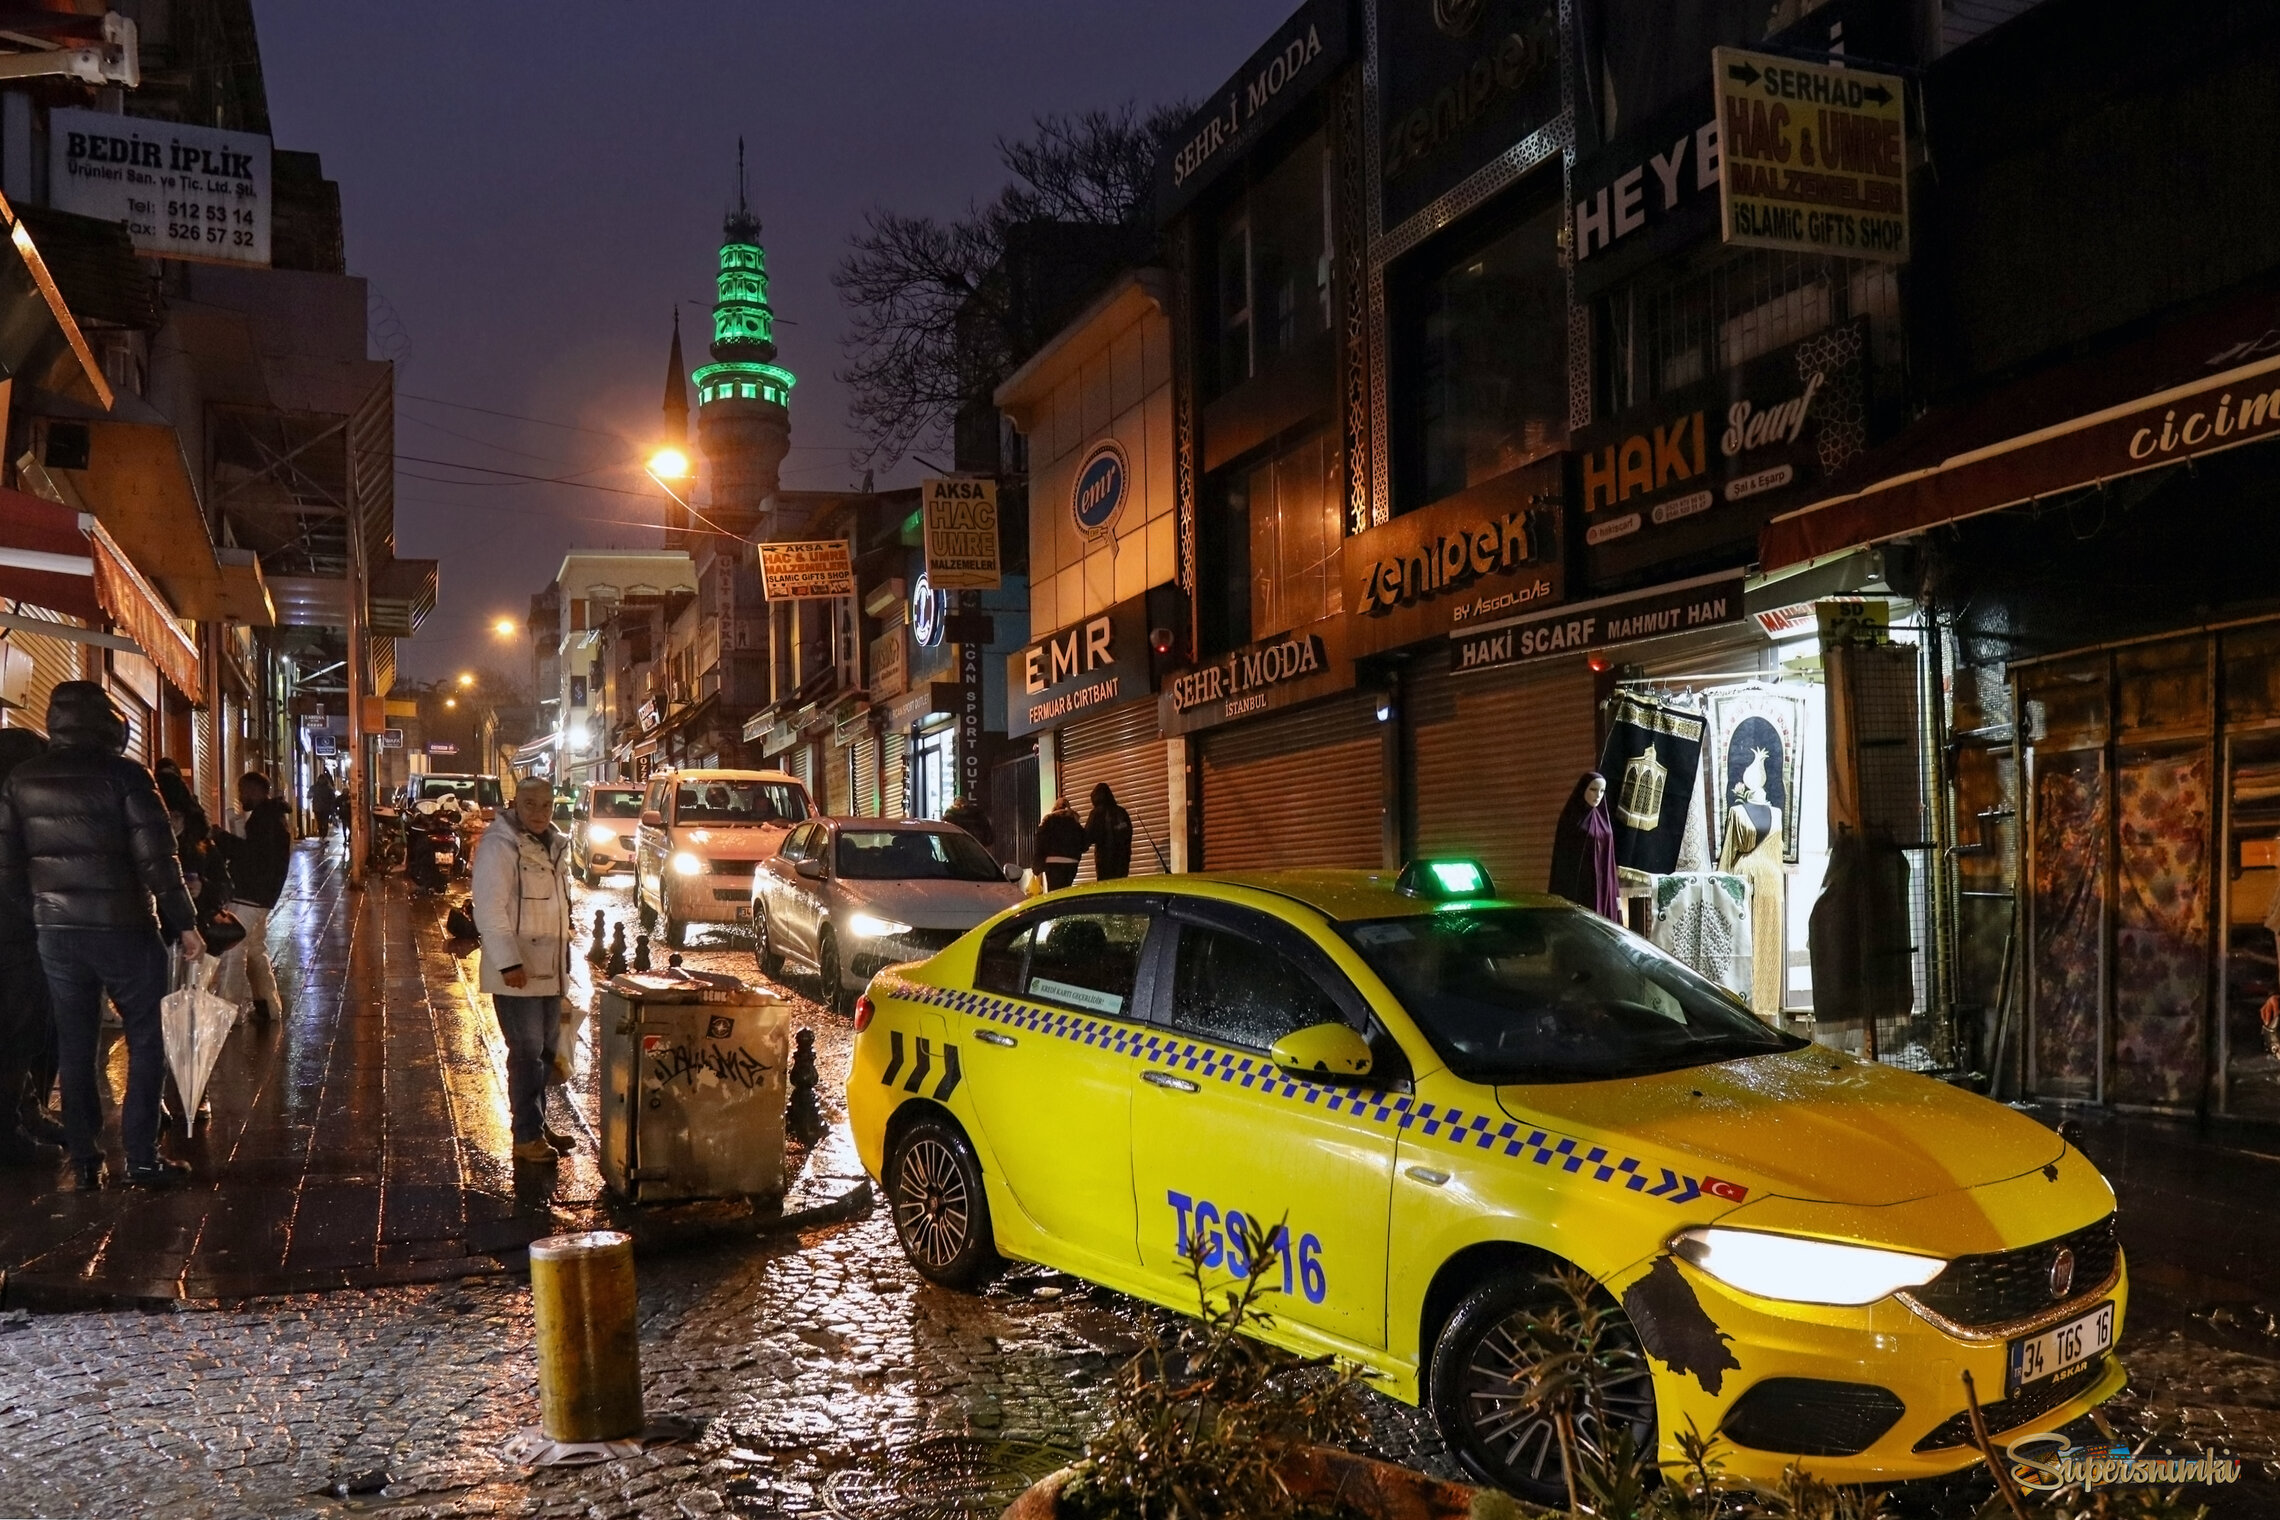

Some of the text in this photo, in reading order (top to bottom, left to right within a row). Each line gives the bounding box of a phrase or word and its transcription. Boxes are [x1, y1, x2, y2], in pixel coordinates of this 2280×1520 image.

[1247, 23, 1323, 119] MODA
[1764, 67, 1862, 108] SERHAD
[1726, 95, 1902, 178] HAC & UMRE
[67, 132, 253, 179] BEDİR İPLİK
[68, 160, 122, 181] Ürünleri
[127, 169, 156, 185] San.
[160, 176, 176, 188] ve
[180, 176, 203, 192] Tic.
[207, 180, 232, 194] Ltd.
[128, 198, 253, 226] Tel: 512 53 14
[169, 224, 200, 241] 526
[207, 228, 226, 244] 57
[233, 230, 254, 247] 32
[1860, 217, 1902, 251] SHOP
[1583, 371, 1825, 513] HAKI Scarf
[935, 483, 984, 499] AKSA
[1081, 465, 1116, 514] emr
[1734, 483, 1749, 497] Şal
[1758, 471, 1785, 489] Eşarp
[929, 501, 996, 530] HAC
[764, 550, 847, 564] HAC & UMRE
[786, 544, 823, 552] AKSA
[931, 531, 995, 557] UMRE
[828, 571, 850, 580] SHOP
[931, 558, 996, 570] MALZEMELERİ
[1454, 603, 1470, 621] BY
[1840, 603, 1864, 616] SD
[1463, 598, 1726, 667] HAKİ SCARF MAHMUT HAN
[1025, 616, 1115, 695] EMR
[1173, 634, 1318, 714] ŞEHR-İ MODA
[1029, 677, 1119, 725] FERMUAR & CIRTBANT
[1226, 693, 1267, 717] İSTANBUL
[966, 691, 978, 749] SPORT
[1167, 1189, 1326, 1304] TGS 16
[2024, 1311, 2109, 1378] 34 TGS 16
[2014, 1366, 2022, 1378] TR
[2052, 1361, 2088, 1384] ASKAR
